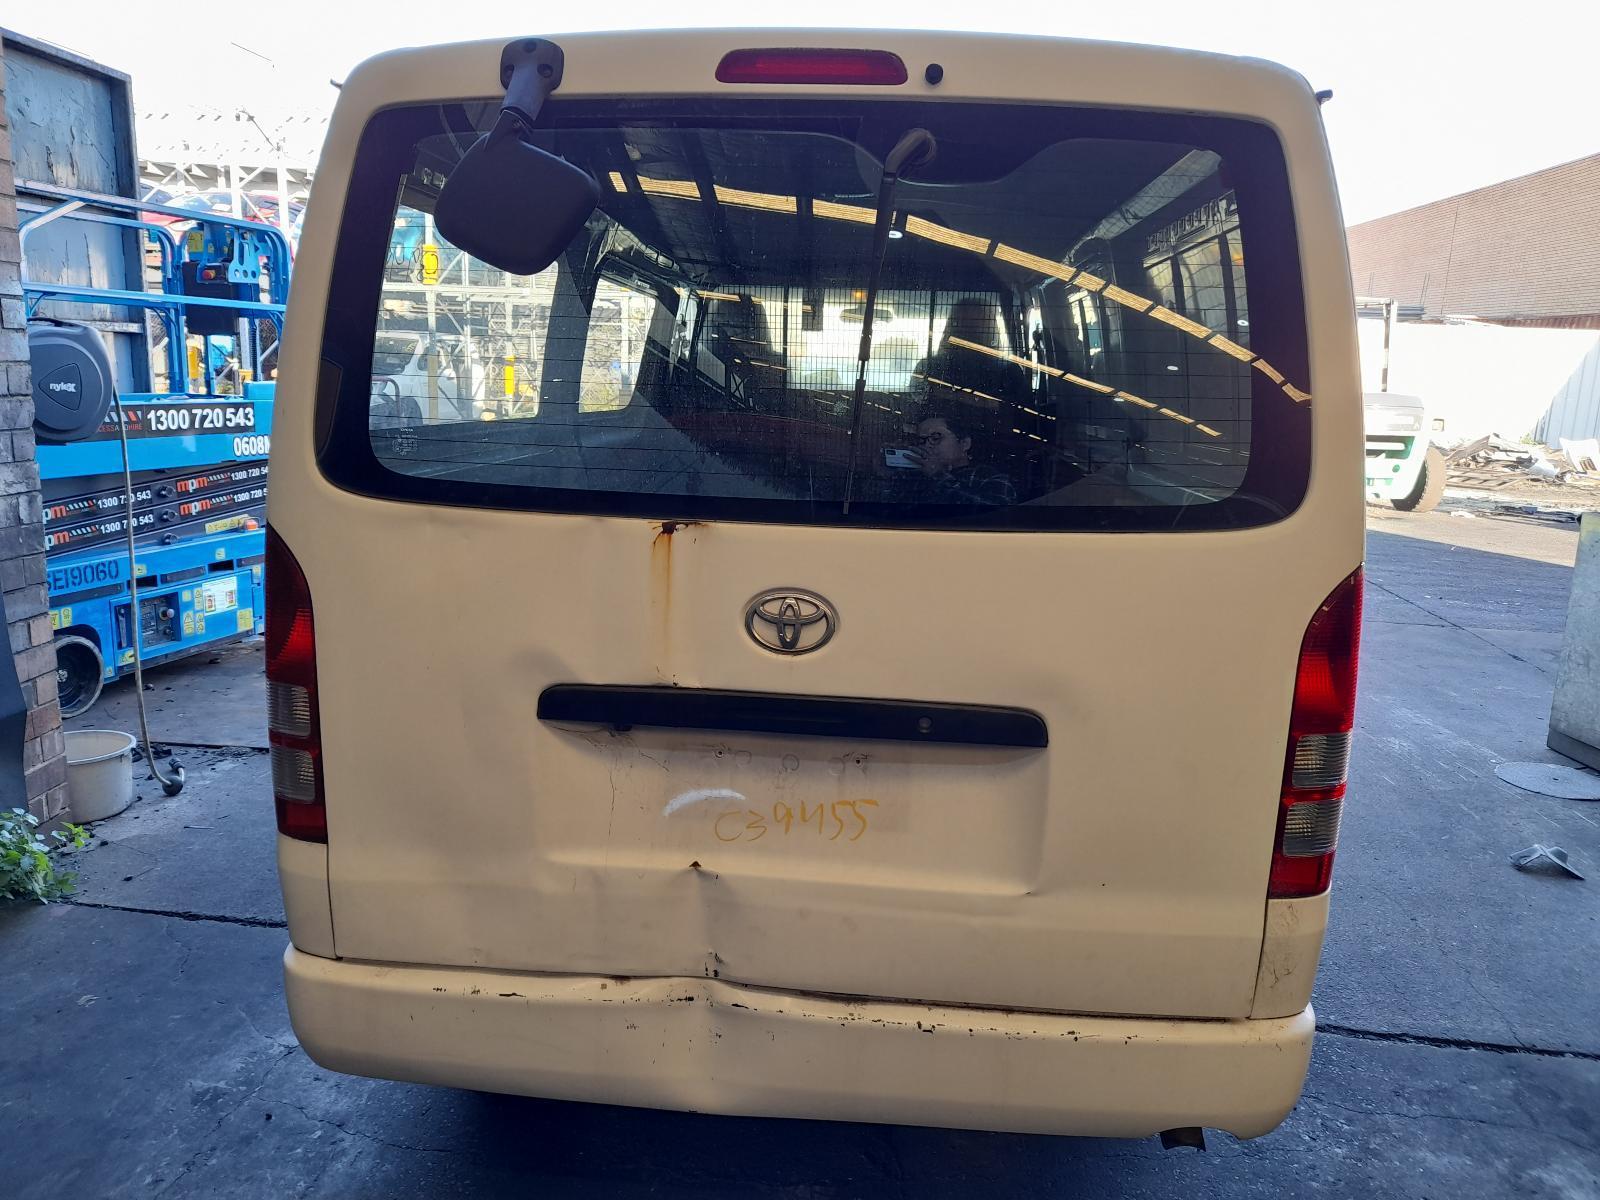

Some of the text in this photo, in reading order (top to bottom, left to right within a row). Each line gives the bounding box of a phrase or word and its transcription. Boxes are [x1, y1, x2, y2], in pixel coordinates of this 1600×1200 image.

[50, 382, 76, 392] nylex
[147, 408, 254, 431] 1300 720 543
[177, 477, 209, 493] mpm
[231, 471, 247, 480] 1300
[247, 468, 260, 477] 720
[97, 496, 118, 509] 1300
[136, 490, 151, 501] 543
[180, 499, 211, 515] mpm
[233, 492, 250, 502] 1300
[250, 488, 262, 499] 720
[100, 522, 120, 534] 1300
[121, 518, 137, 529] 70
[139, 514, 154, 525] 543
